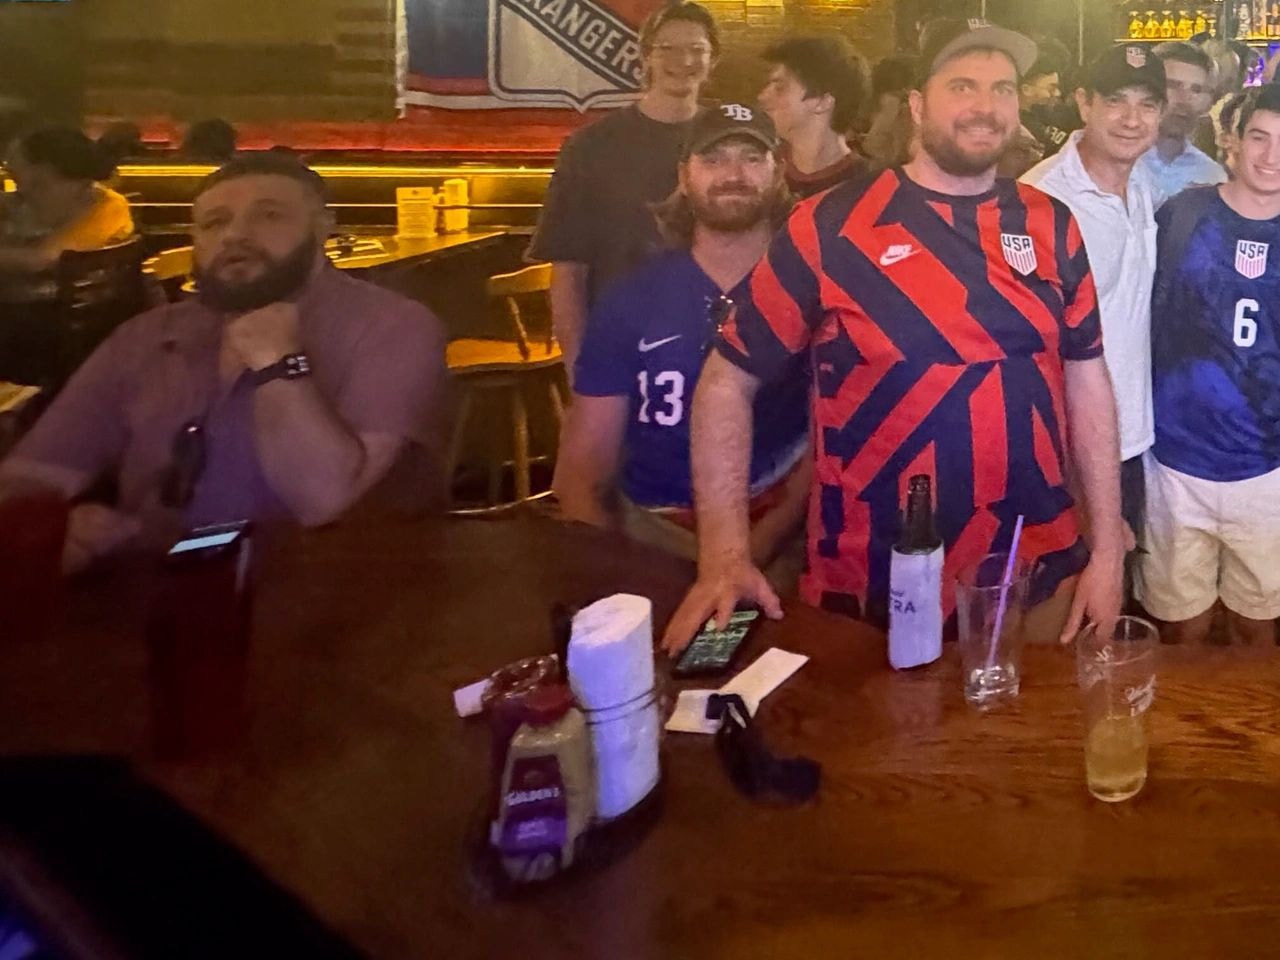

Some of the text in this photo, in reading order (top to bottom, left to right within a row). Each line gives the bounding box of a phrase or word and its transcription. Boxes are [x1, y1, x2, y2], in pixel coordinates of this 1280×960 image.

[1002, 235, 1031, 252] USA
[1239, 242, 1266, 259] USA
[1233, 298, 1259, 347] 6
[637, 370, 685, 426] 13
